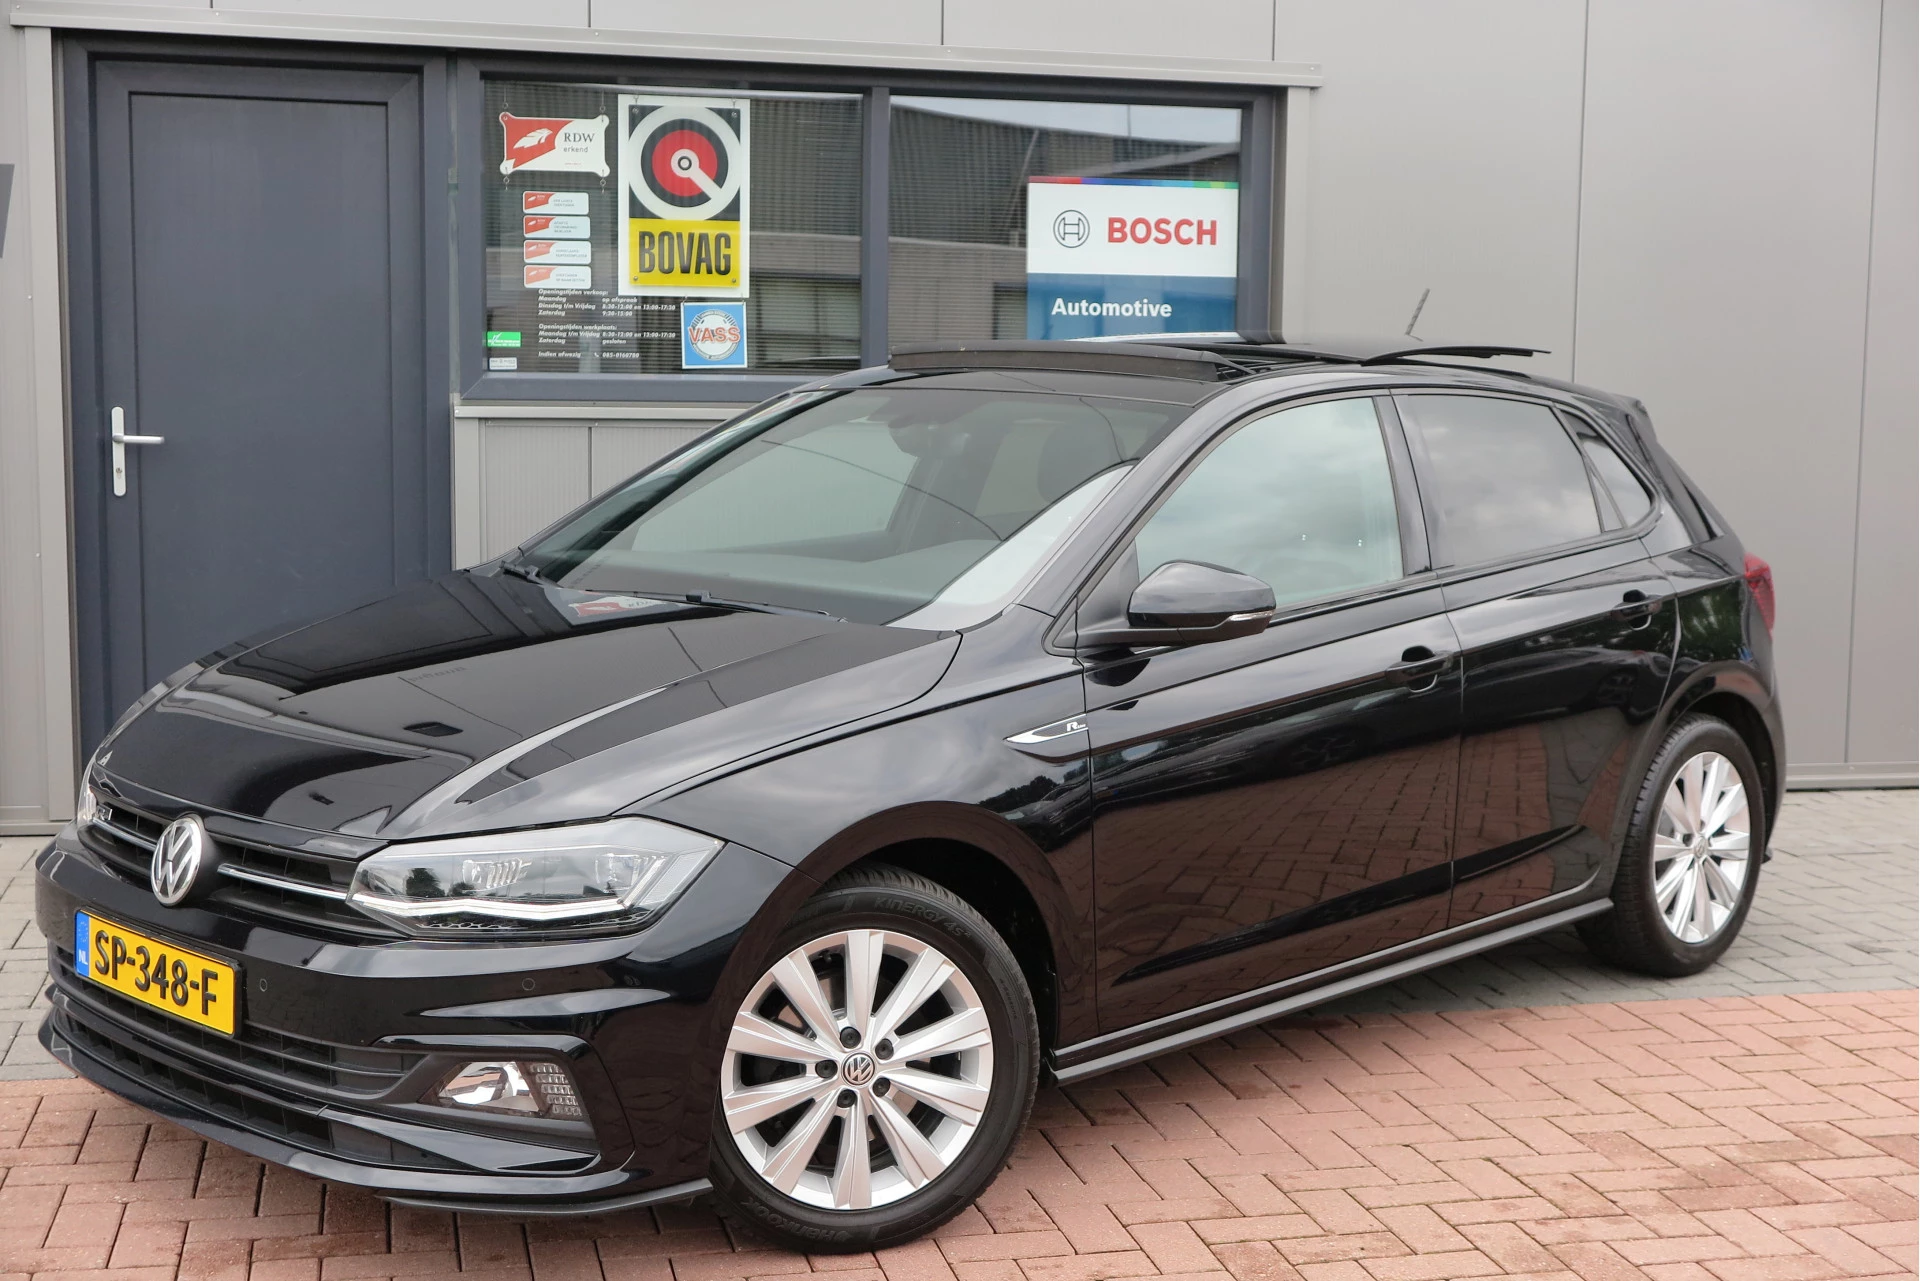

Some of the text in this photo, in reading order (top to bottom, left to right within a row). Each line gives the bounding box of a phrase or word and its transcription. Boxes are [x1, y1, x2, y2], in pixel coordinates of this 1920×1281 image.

[564, 132, 595, 143] RDW
[563, 145, 589, 153] erkend
[1107, 216, 1218, 246] BOSCH
[638, 230, 731, 276] BOVAG
[1051, 297, 1173, 318] Automotive
[583, 323, 617, 331] werkplaats:
[688, 326, 741, 344] VASS
[557, 351, 582, 359] afwezig
[78, 950, 88, 966] NL
[94, 929, 218, 1016] SP-348-F
